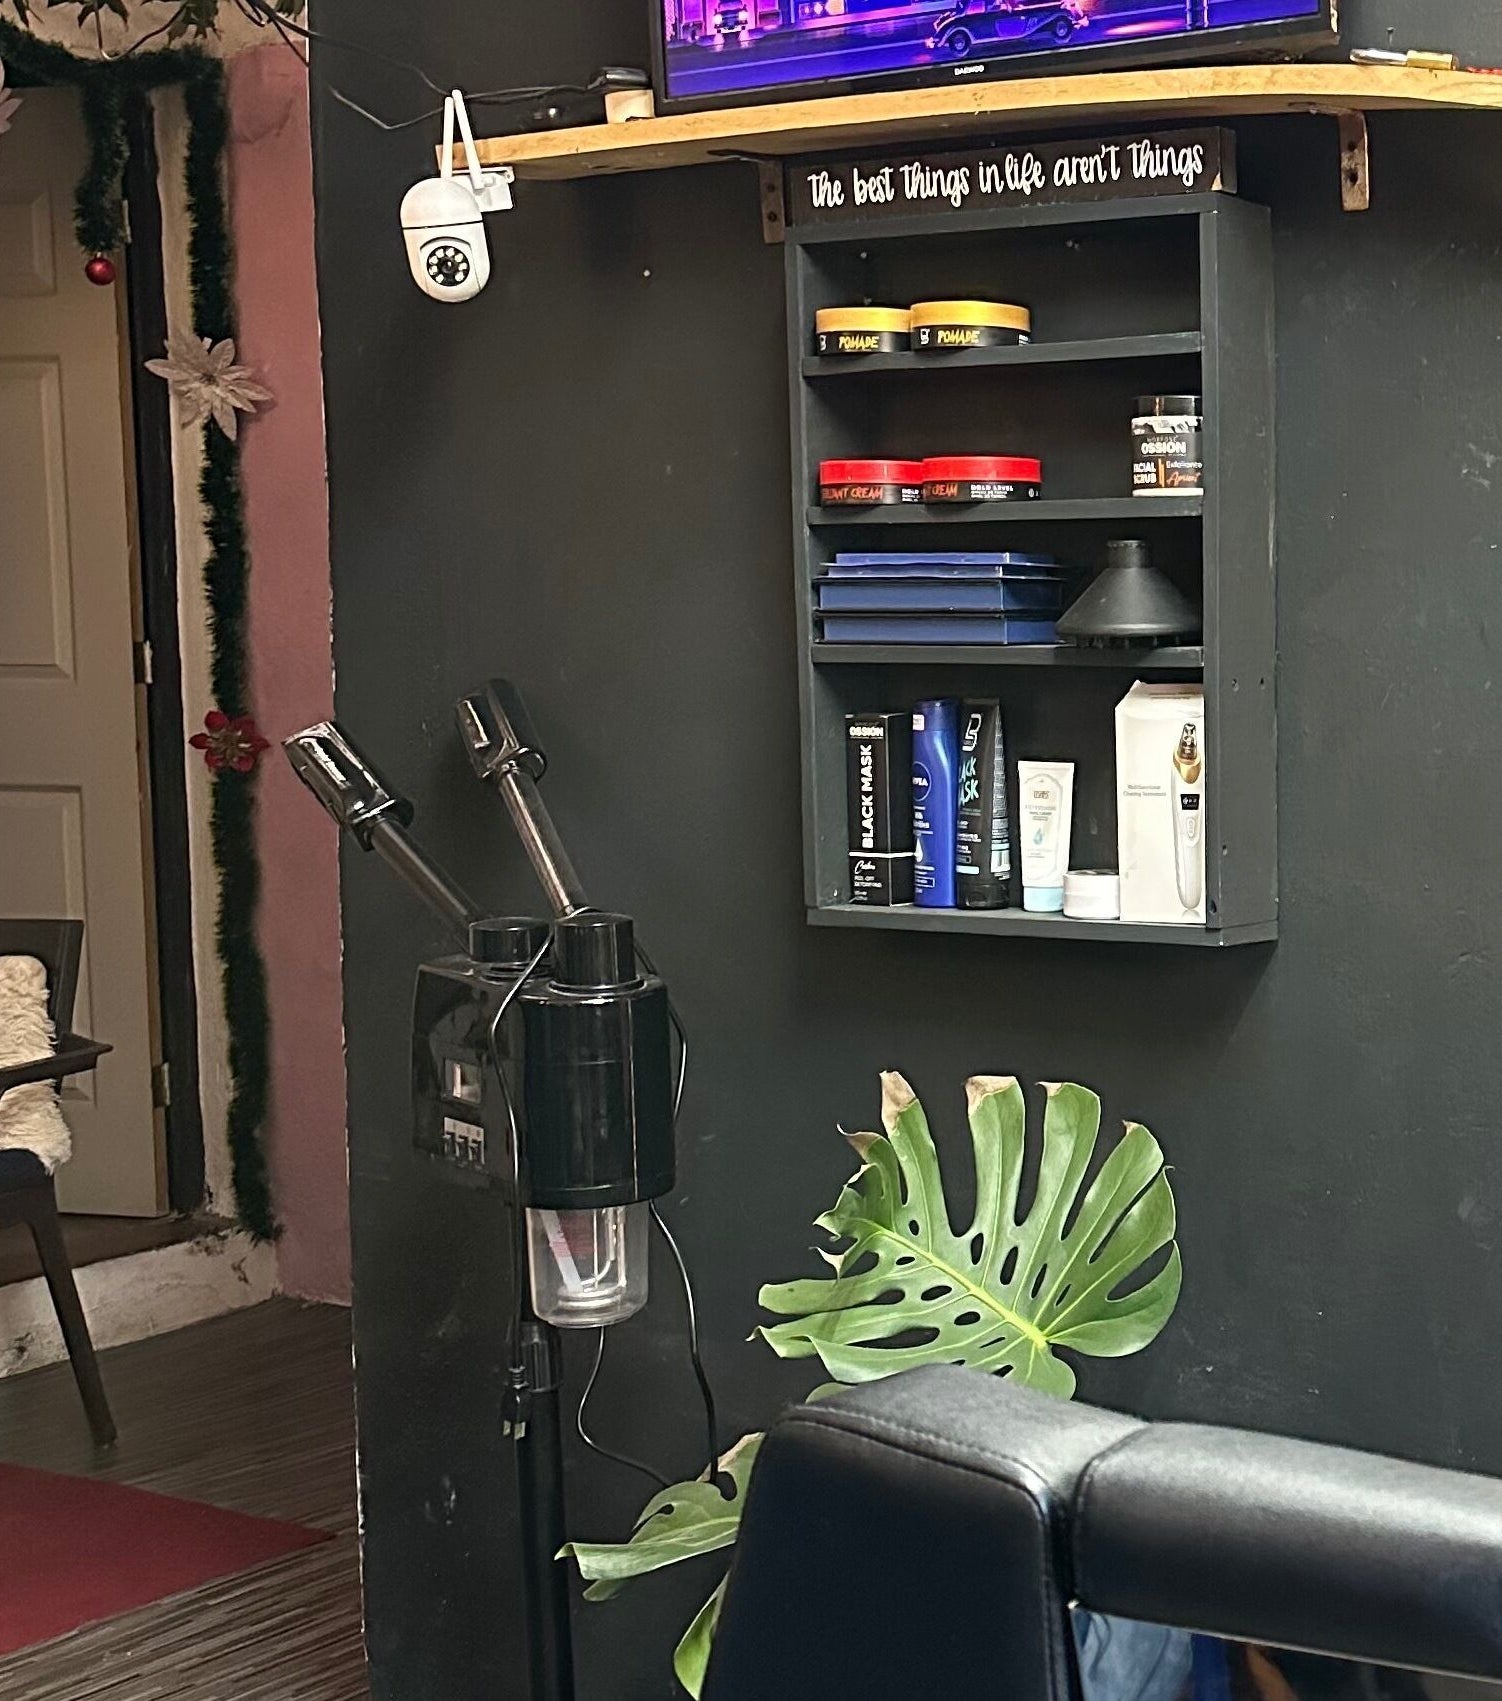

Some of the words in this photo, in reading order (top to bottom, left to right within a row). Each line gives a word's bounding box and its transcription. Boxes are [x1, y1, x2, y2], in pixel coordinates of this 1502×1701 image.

[853, 167, 894, 205] best
[978, 160, 1004, 194] in
[1006, 153, 1045, 195] life
[1054, 144, 1120, 187] aren't
[838, 332, 880, 350] POMADE
[937, 328, 981, 345] POMADE
[1141, 442, 1187, 454] OSSION
[851, 486, 883, 499] CREAM
[860, 744, 873, 792] MASK
[959, 756, 976, 783] ACK
[959, 780, 979, 806] ASK
[861, 794, 874, 849] BLACK
